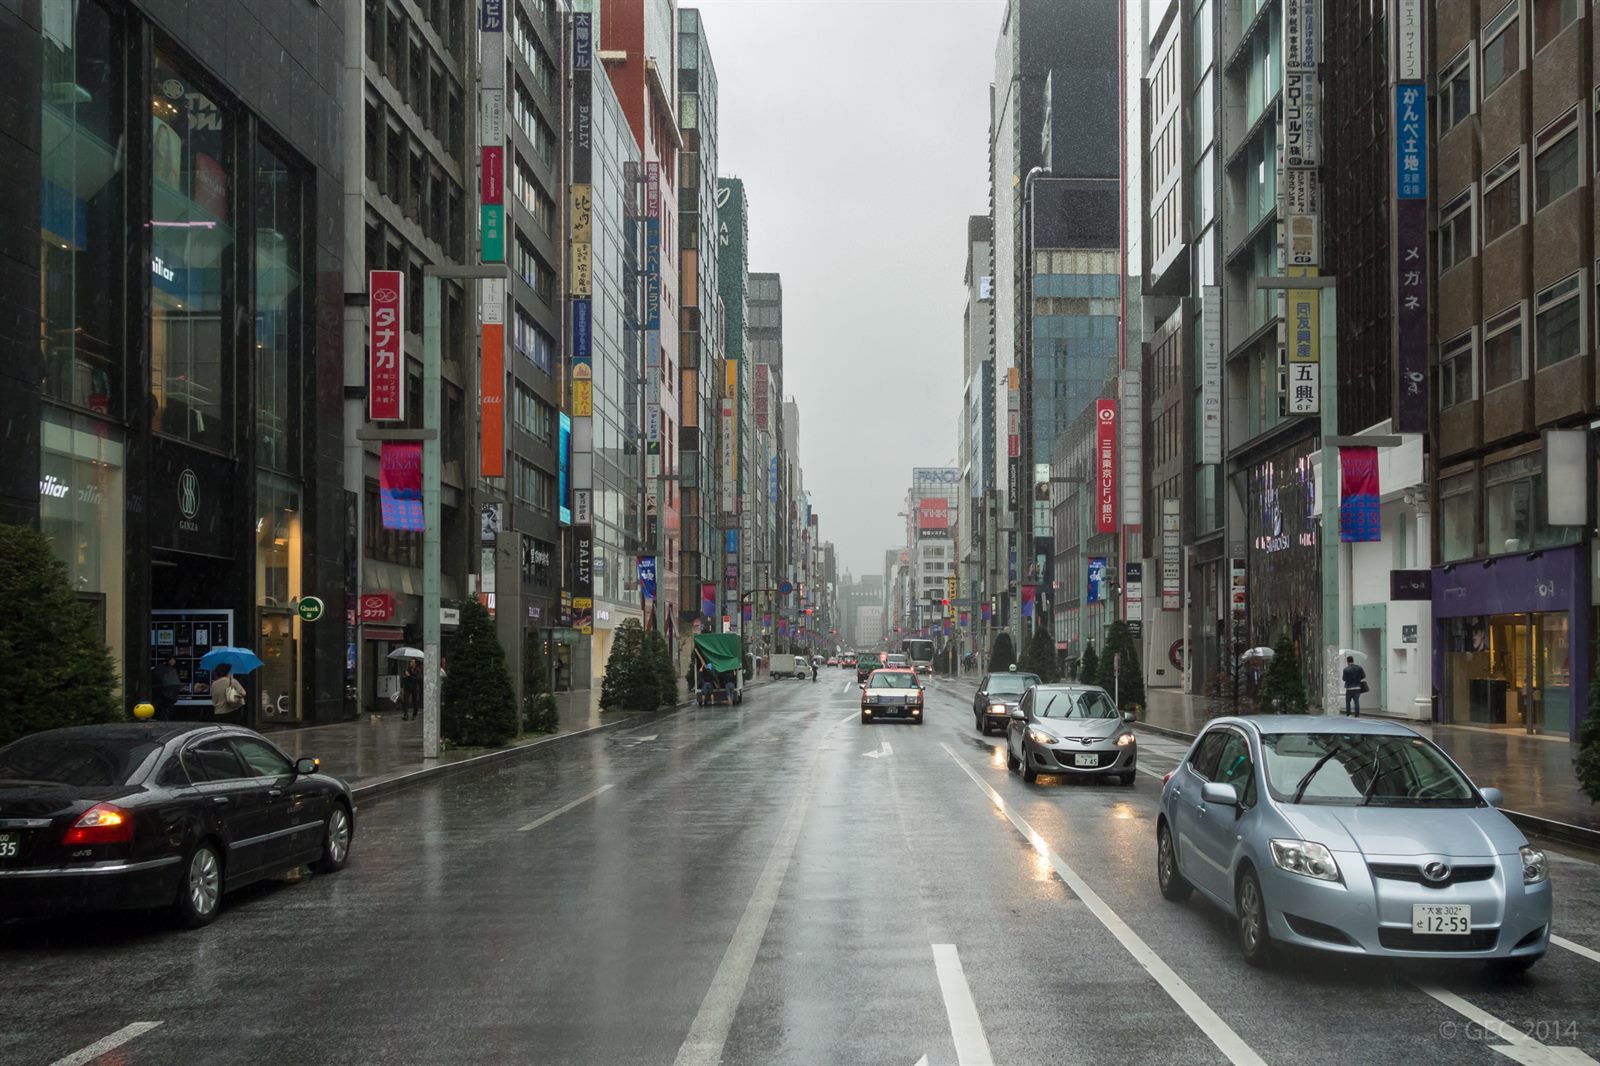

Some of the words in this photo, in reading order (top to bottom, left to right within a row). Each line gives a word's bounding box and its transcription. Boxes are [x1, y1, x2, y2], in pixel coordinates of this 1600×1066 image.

[486, 0, 500, 28] ビル
[579, 105, 589, 149] BALLY
[1403, 88, 1419, 172] かんべ土地
[1405, 246, 1420, 309] メガネ
[376, 307, 396, 369] タナカ
[483, 395, 502, 404] au
[1295, 365, 1314, 403] 五興
[1102, 439, 1112, 524] 三菱東京UFJ銀行
[179, 519, 199, 532] GINZA
[579, 540, 590, 585] BALLY
[364, 610, 386, 618] タナカ
[1428, 916, 1468, 932] 12-59
[1444, 906, 1458, 916] 302
